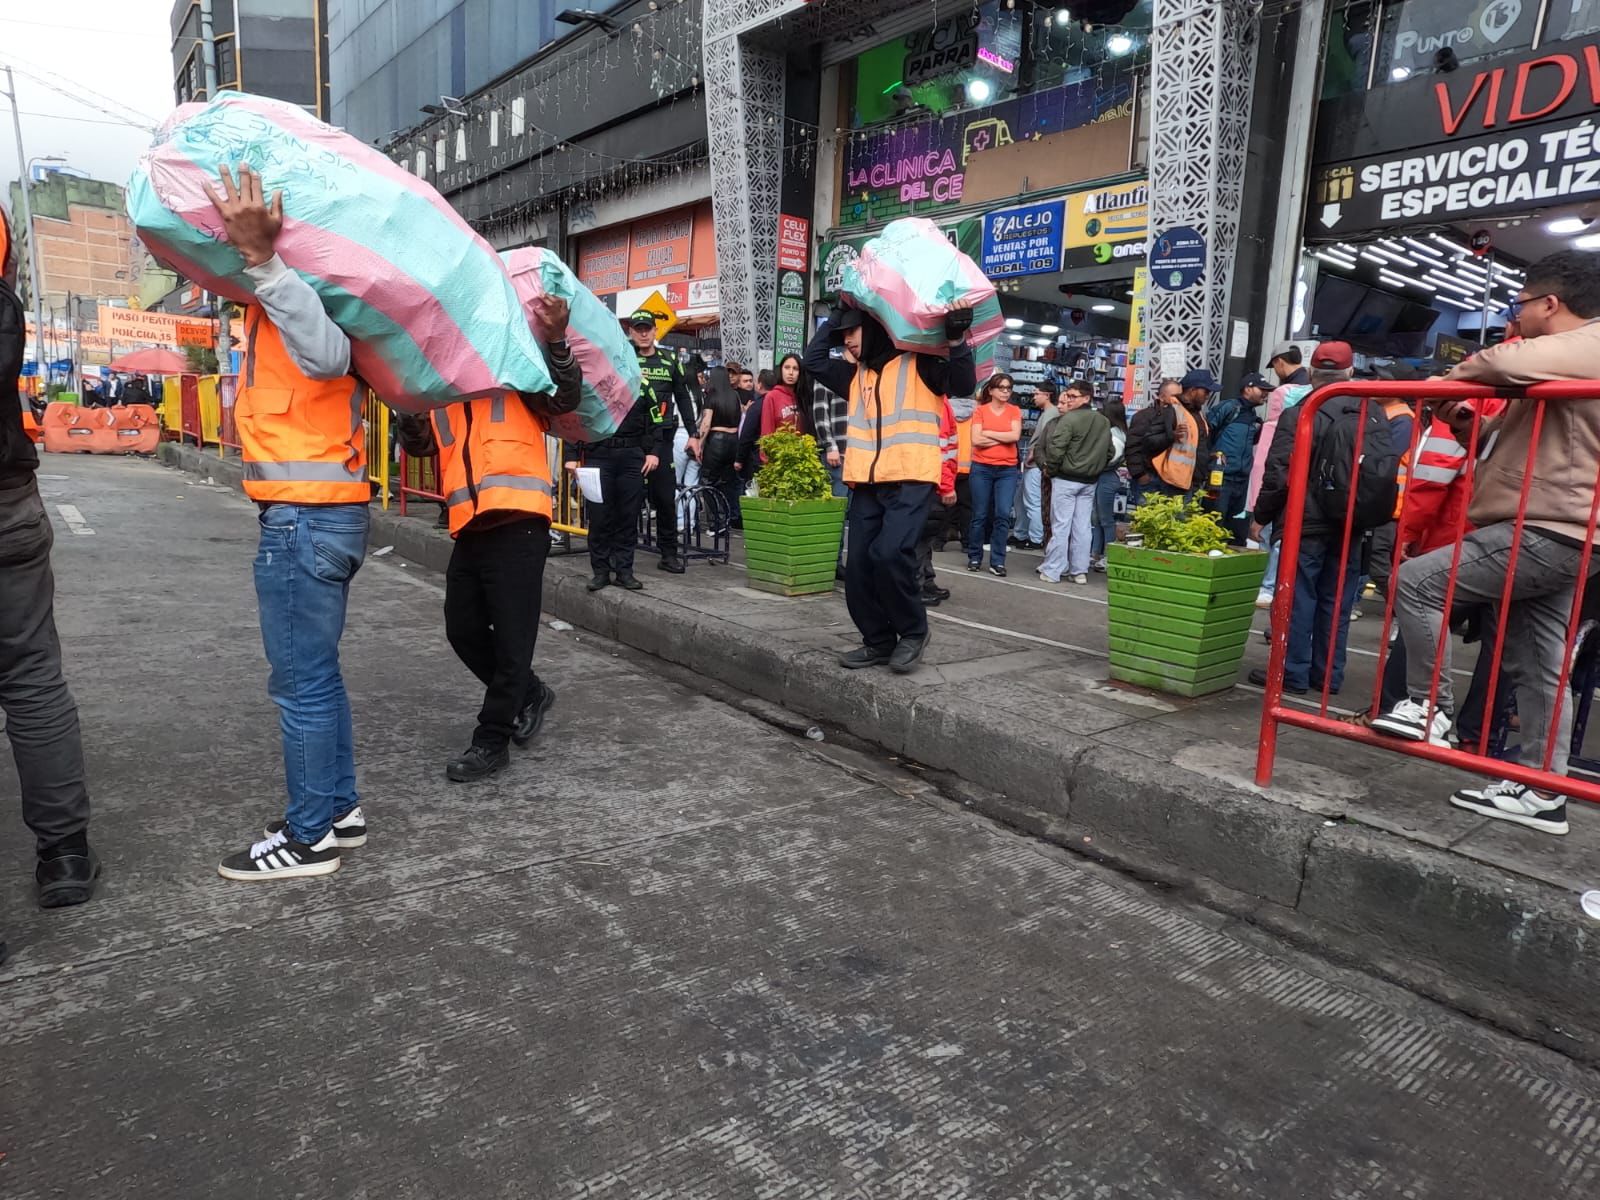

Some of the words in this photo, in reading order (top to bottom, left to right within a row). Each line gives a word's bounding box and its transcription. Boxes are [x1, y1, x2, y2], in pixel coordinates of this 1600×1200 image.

[1394, 26, 1474, 60] PUNTO
[1488, 3, 1513, 30] 13
[908, 41, 970, 77] PARRA
[849, 168, 868, 187] LA
[870, 149, 956, 188] CLINICA
[1359, 138, 1529, 193] SERVICIO
[901, 182, 930, 202] DEL
[783, 219, 806, 231] CELU
[1004, 211, 1053, 234] ALEJO
[783, 229, 806, 243] FLEX
[1002, 227, 1048, 241] REPUESTOS
[992, 240, 1027, 254] VENTAS
[1029, 236, 1049, 248] POR
[985, 252, 1016, 264] MAYOR
[1018, 250, 1025, 260] Y
[1026, 246, 1055, 259] DETAL
[986, 260, 1025, 275] LOCAL
[1029, 257, 1054, 271] 109
[780, 298, 805, 311] Parra
[779, 325, 803, 335] VENTAS
[783, 333, 798, 341] POR
[779, 340, 802, 349] MAYOR
